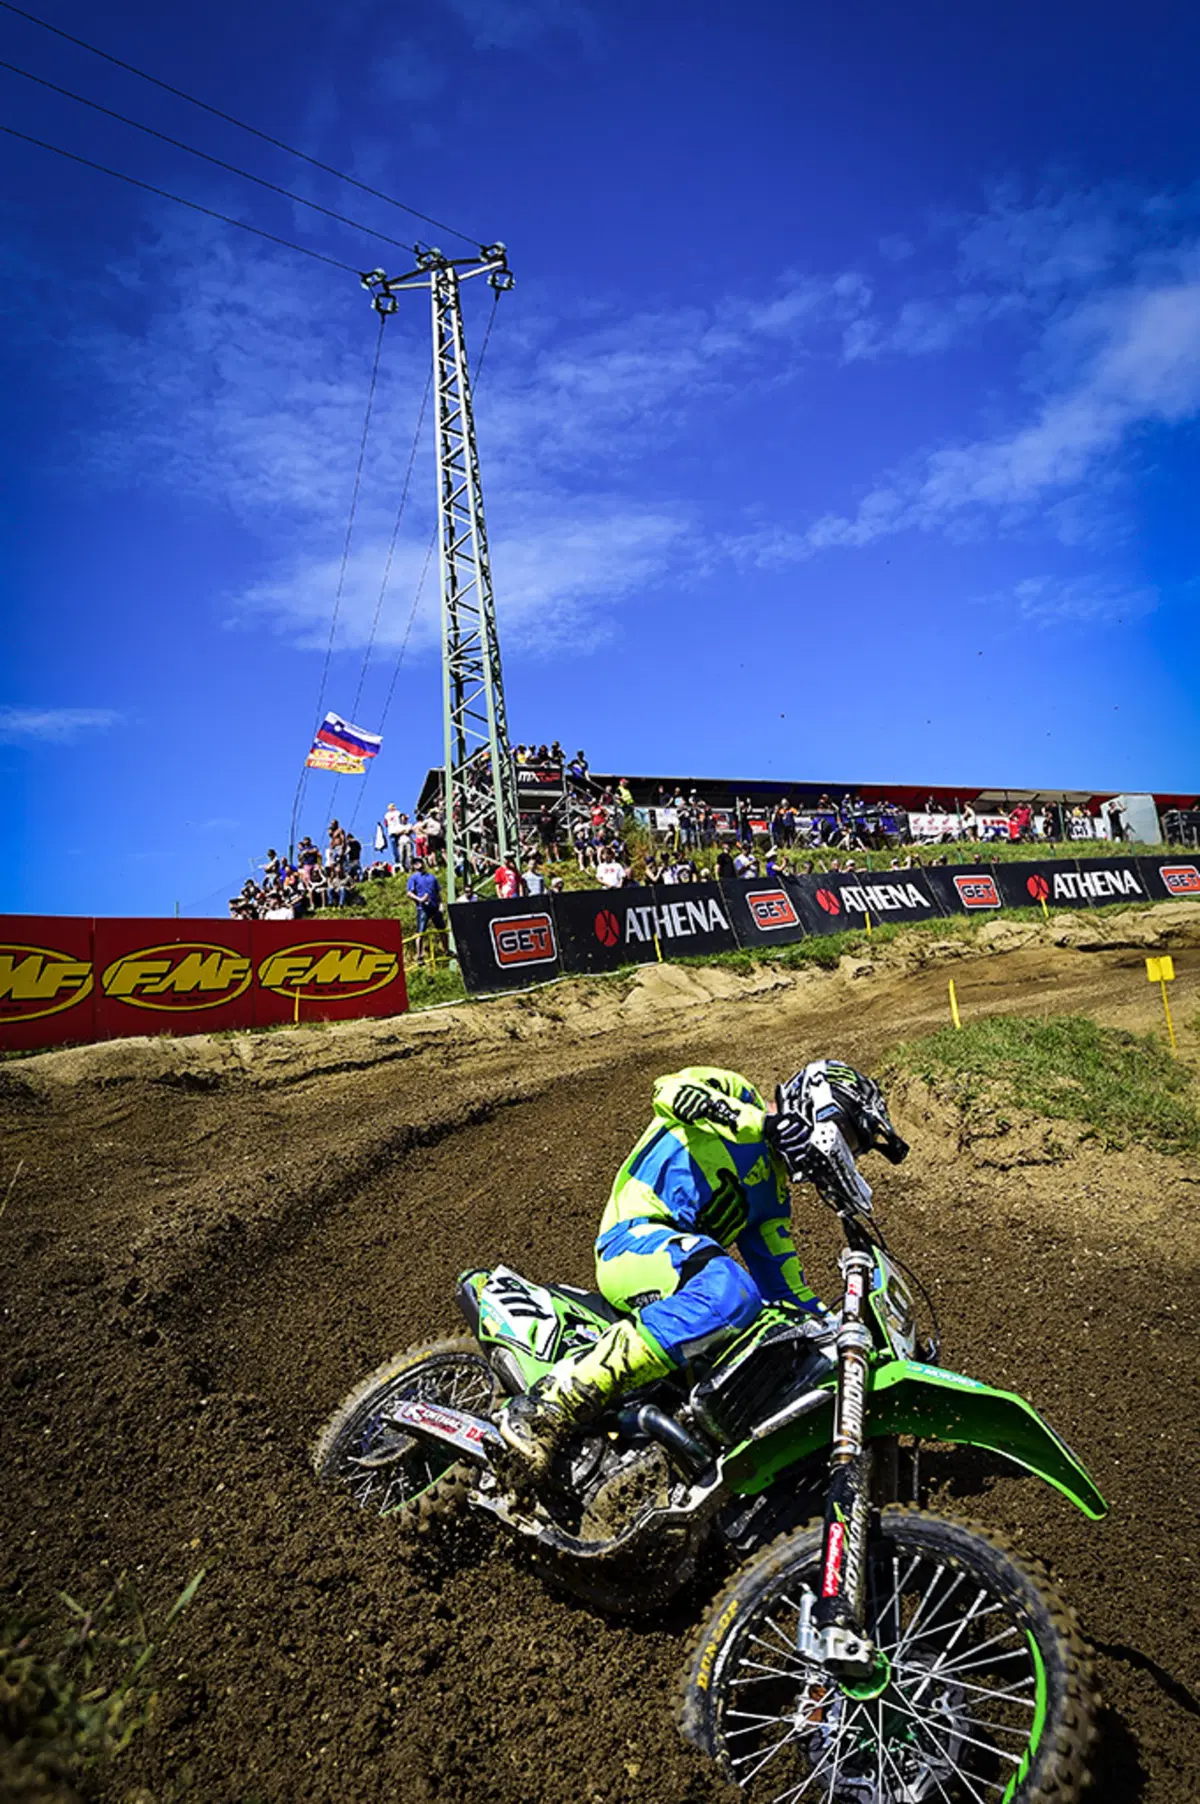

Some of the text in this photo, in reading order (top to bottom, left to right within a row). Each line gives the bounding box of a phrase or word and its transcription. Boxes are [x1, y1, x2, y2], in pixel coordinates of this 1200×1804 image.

[840, 884, 931, 914] ATHENA
[962, 882, 992, 899] GET
[1053, 869, 1142, 899] ATHENA
[1167, 873, 1198, 888] GET
[624, 898, 730, 944] ATHENA
[752, 900, 788, 919] GET
[497, 926, 548, 952] GET
[0, 954, 93, 1001] MF
[105, 952, 251, 996] FMF
[261, 948, 397, 987] FMF
[841, 1358, 865, 1438] SHOWA
[845, 1498, 868, 1605] DUNLOP
[696, 1599, 738, 1691] DUNLOP
